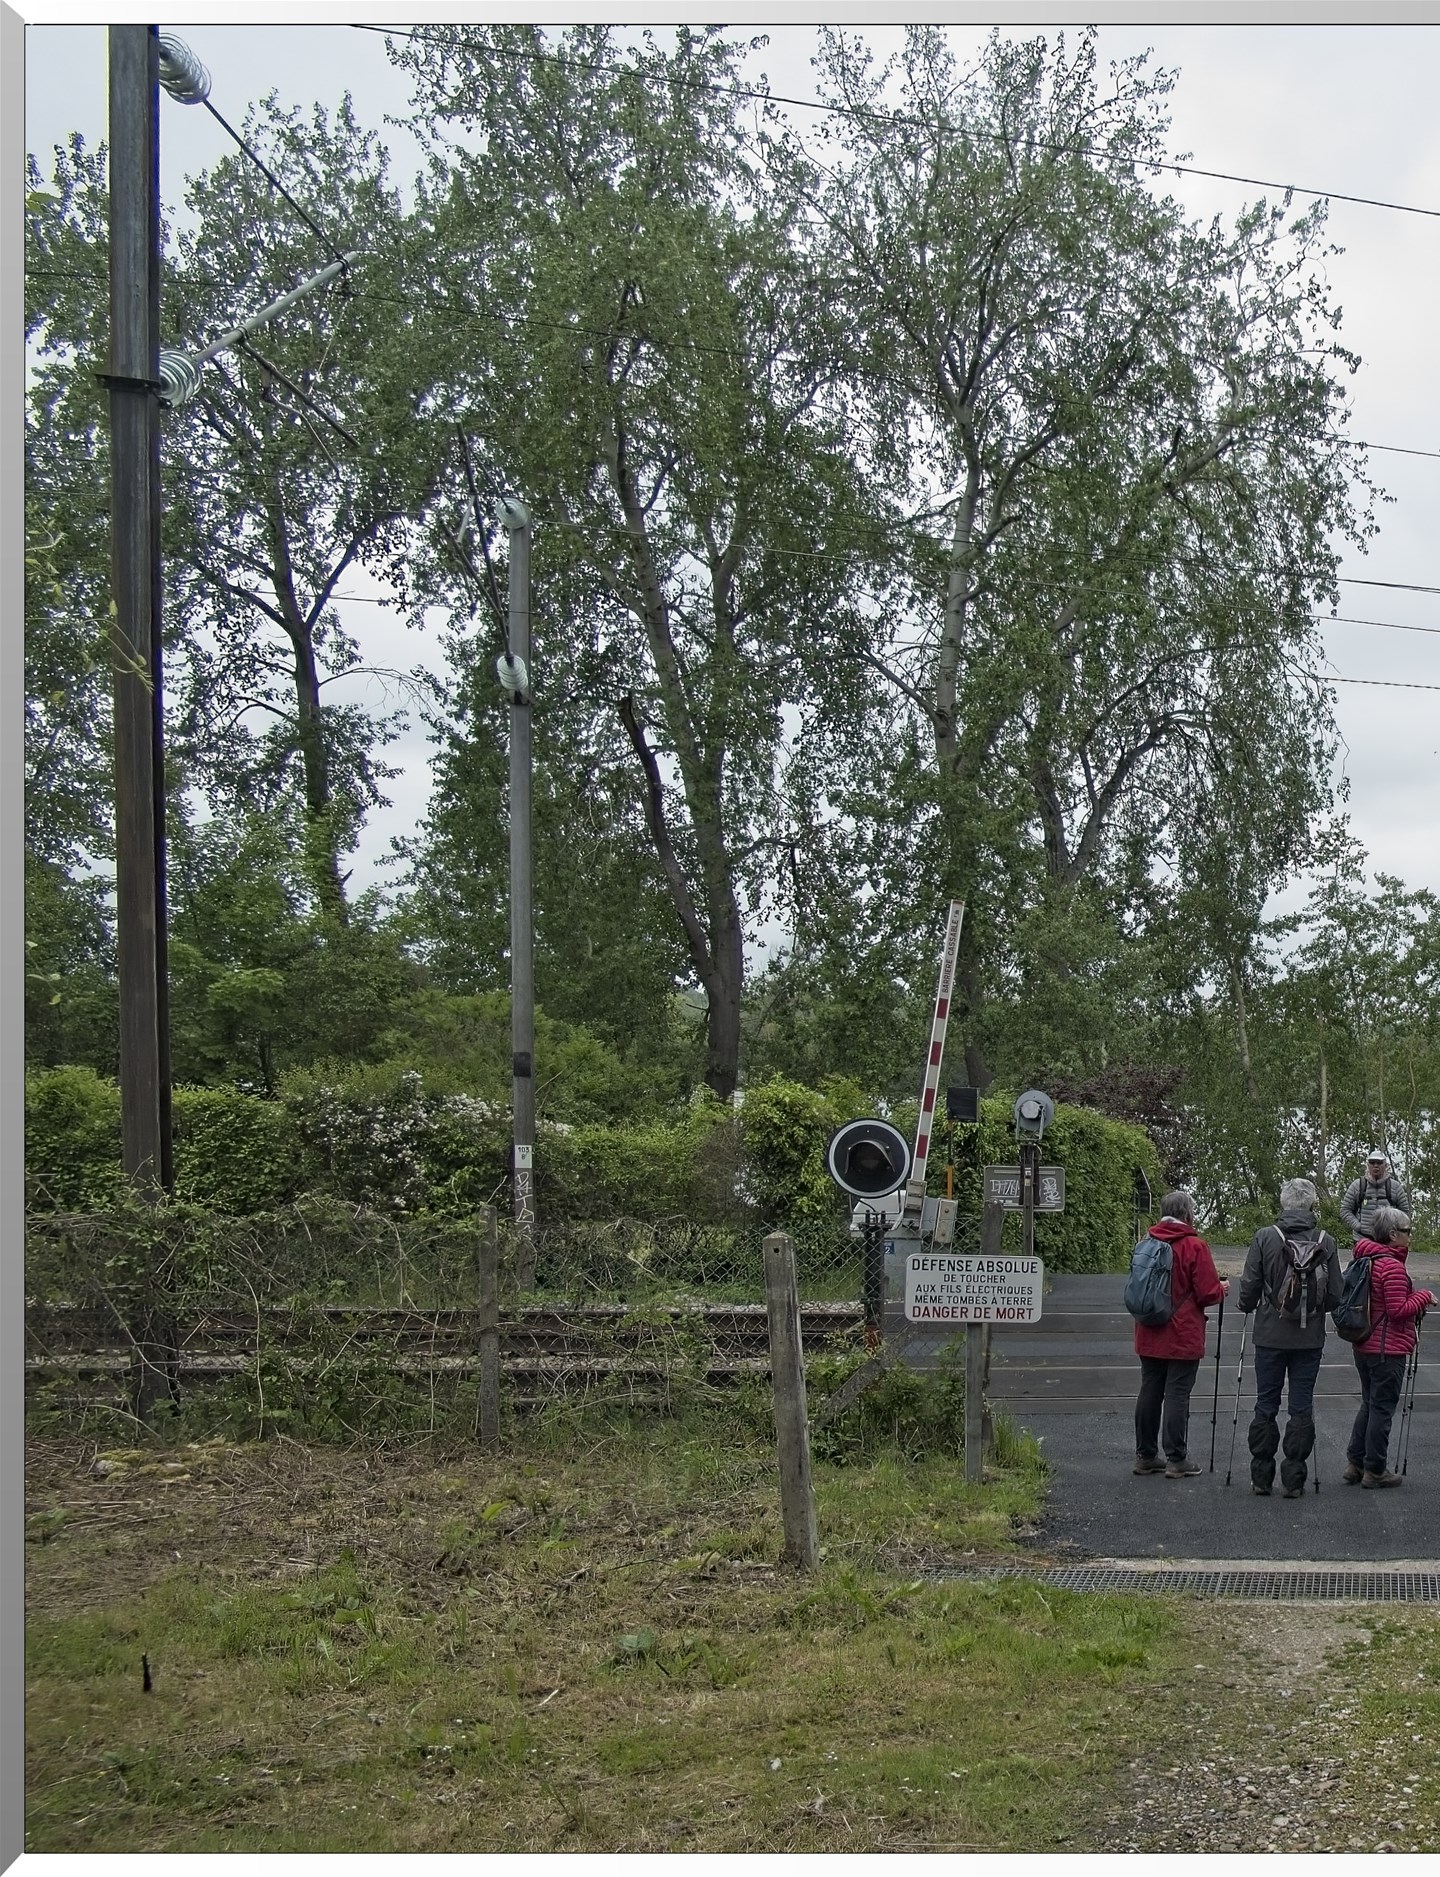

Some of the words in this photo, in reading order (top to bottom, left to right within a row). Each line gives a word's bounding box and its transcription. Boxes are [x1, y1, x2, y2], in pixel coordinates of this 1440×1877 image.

[912, 1257, 973, 1272] DÉFENSE
[976, 1260, 1038, 1273] ABSOLUE
[943, 1273, 957, 1283] DE
[960, 1274, 1006, 1283] TOUCHER
[915, 1284, 936, 1293] AUX
[940, 1284, 962, 1293] FILS
[965, 1283, 1033, 1295] ÉLECTRIQUES
[914, 1292, 943, 1304] MÊME
[946, 1294, 988, 1305] TOMBÉS
[1000, 1296, 1033, 1306] TERRE
[912, 1305, 969, 1318] DANGER
[973, 1306, 991, 1319] DE
[996, 1307, 1035, 1320] MORT
